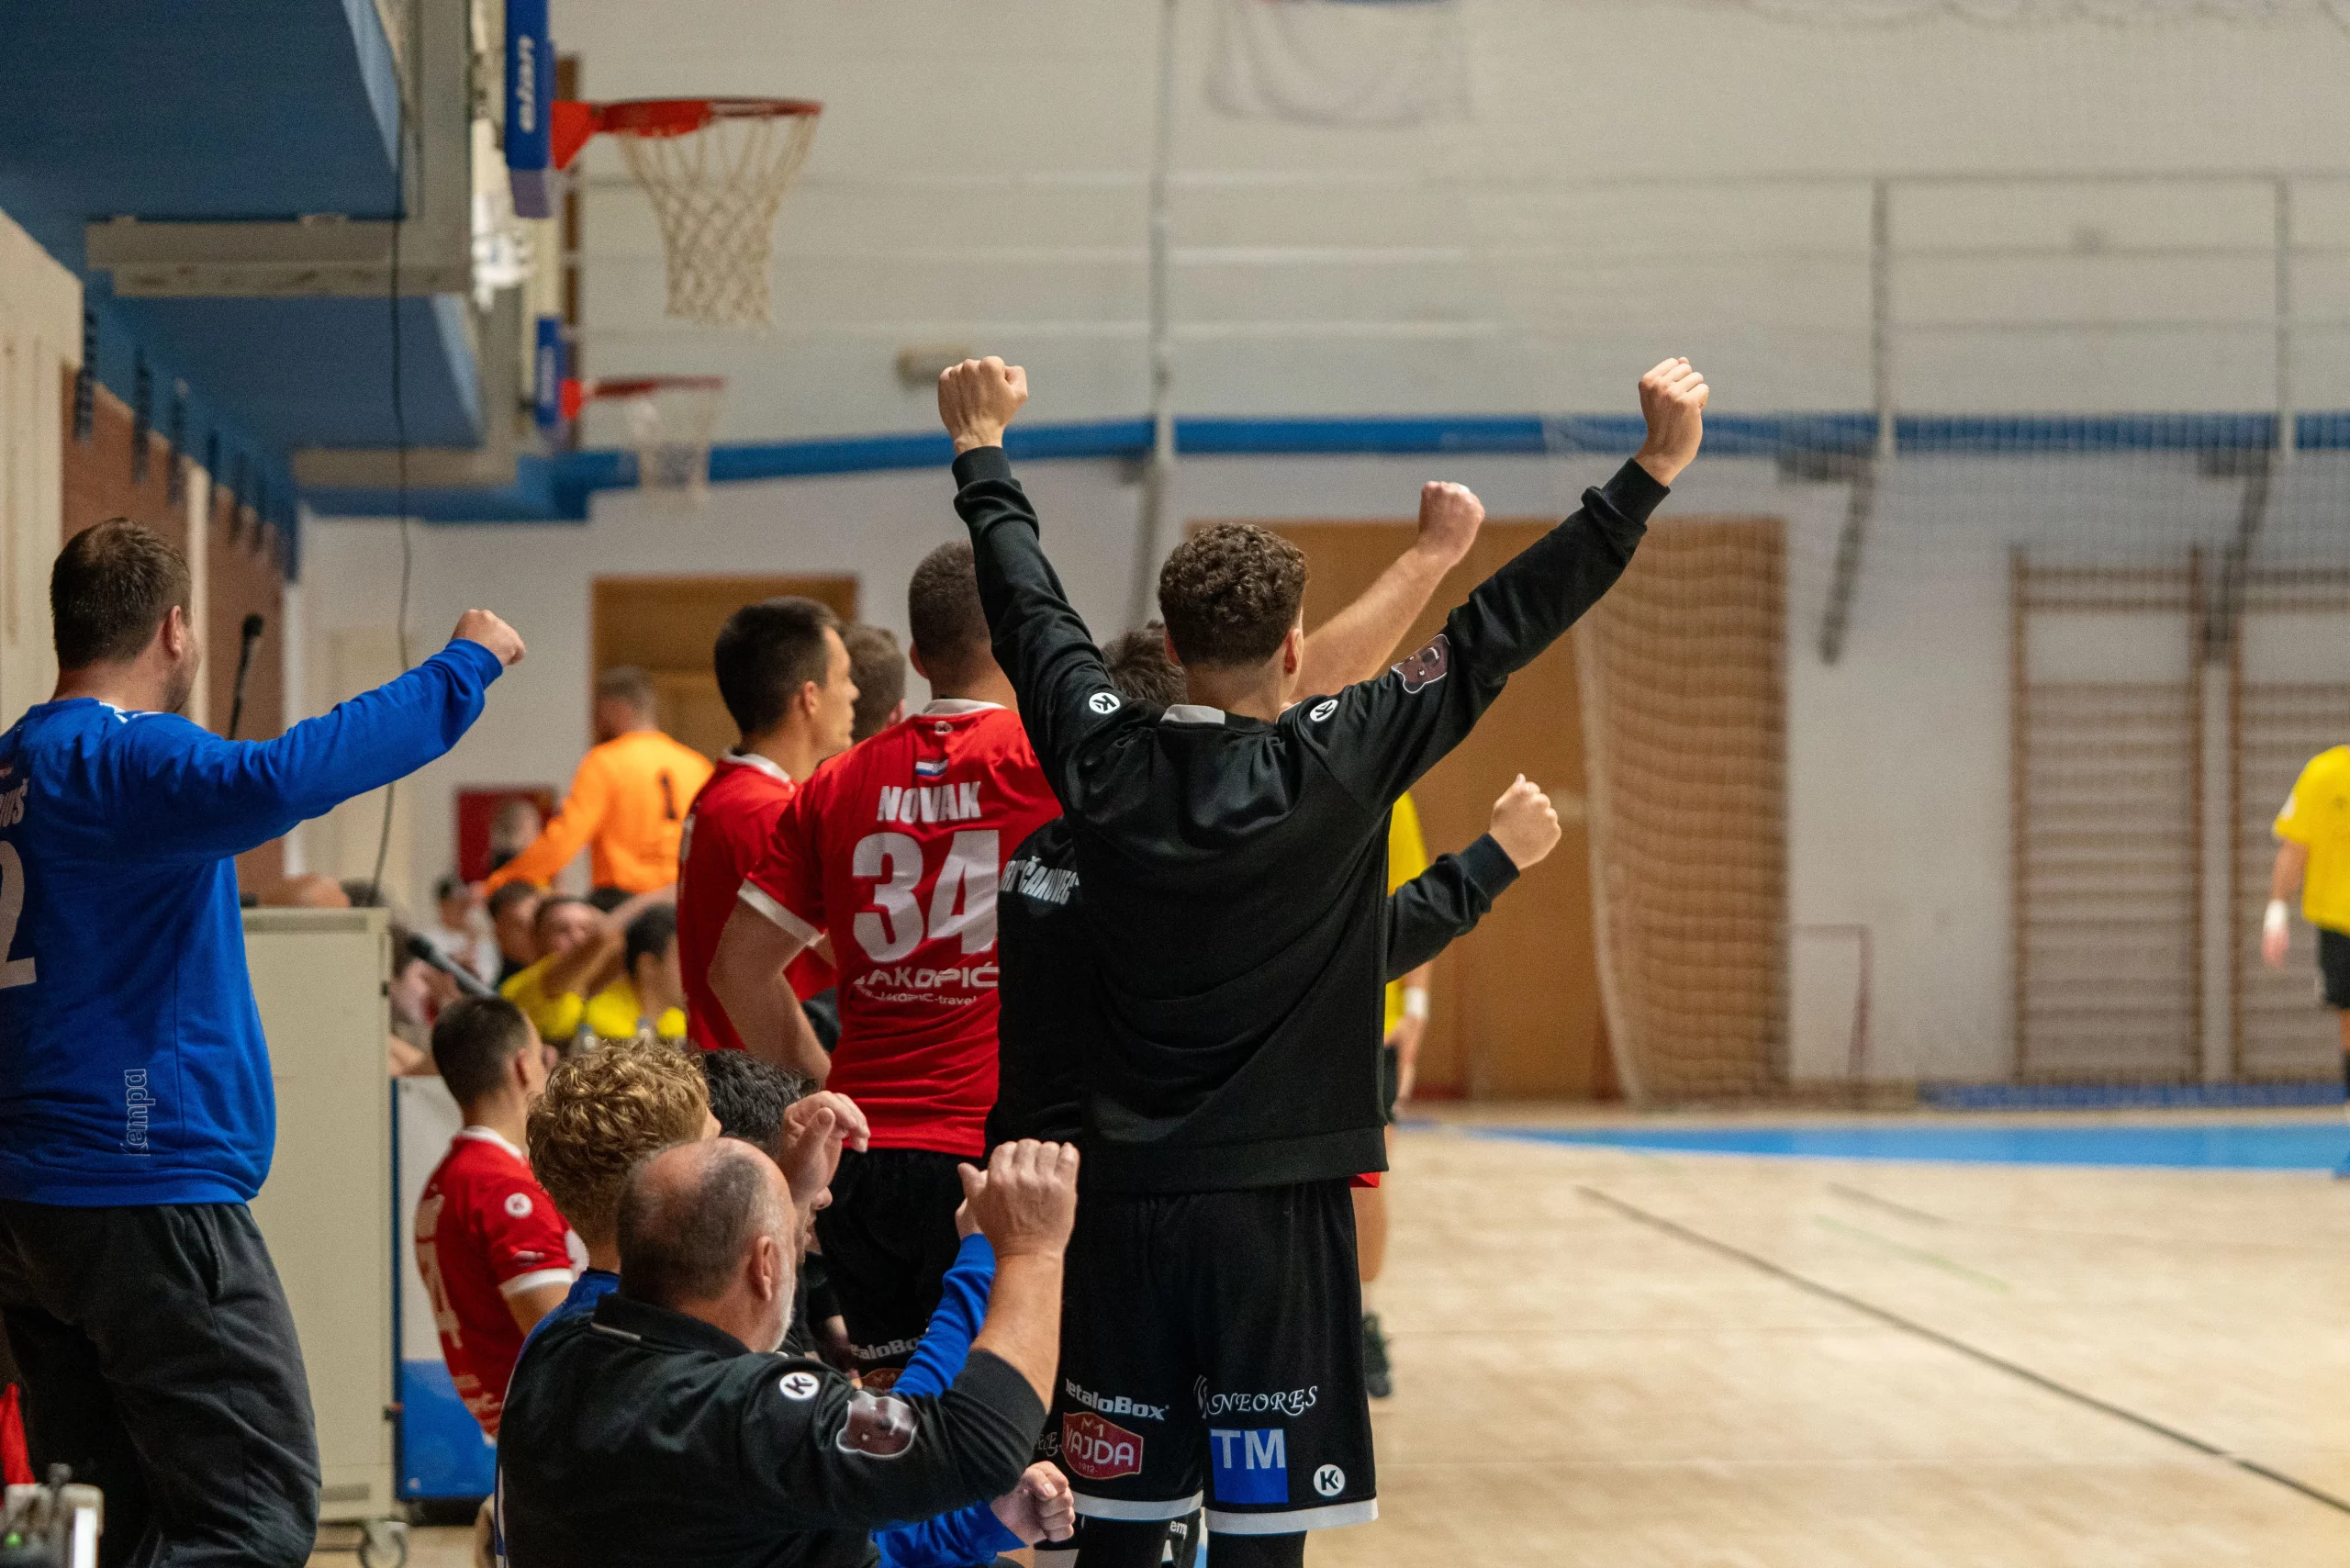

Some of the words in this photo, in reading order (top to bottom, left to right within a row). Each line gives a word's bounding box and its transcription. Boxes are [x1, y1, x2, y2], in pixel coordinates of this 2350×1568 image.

[877, 780, 982, 824] NOVAK
[852, 829, 1000, 963] 34
[1207, 1385, 1318, 1416] NEORES
[1065, 1424, 1135, 1467] VAJDA
[1211, 1428, 1286, 1470] TM
[1318, 1468, 1340, 1492] K
